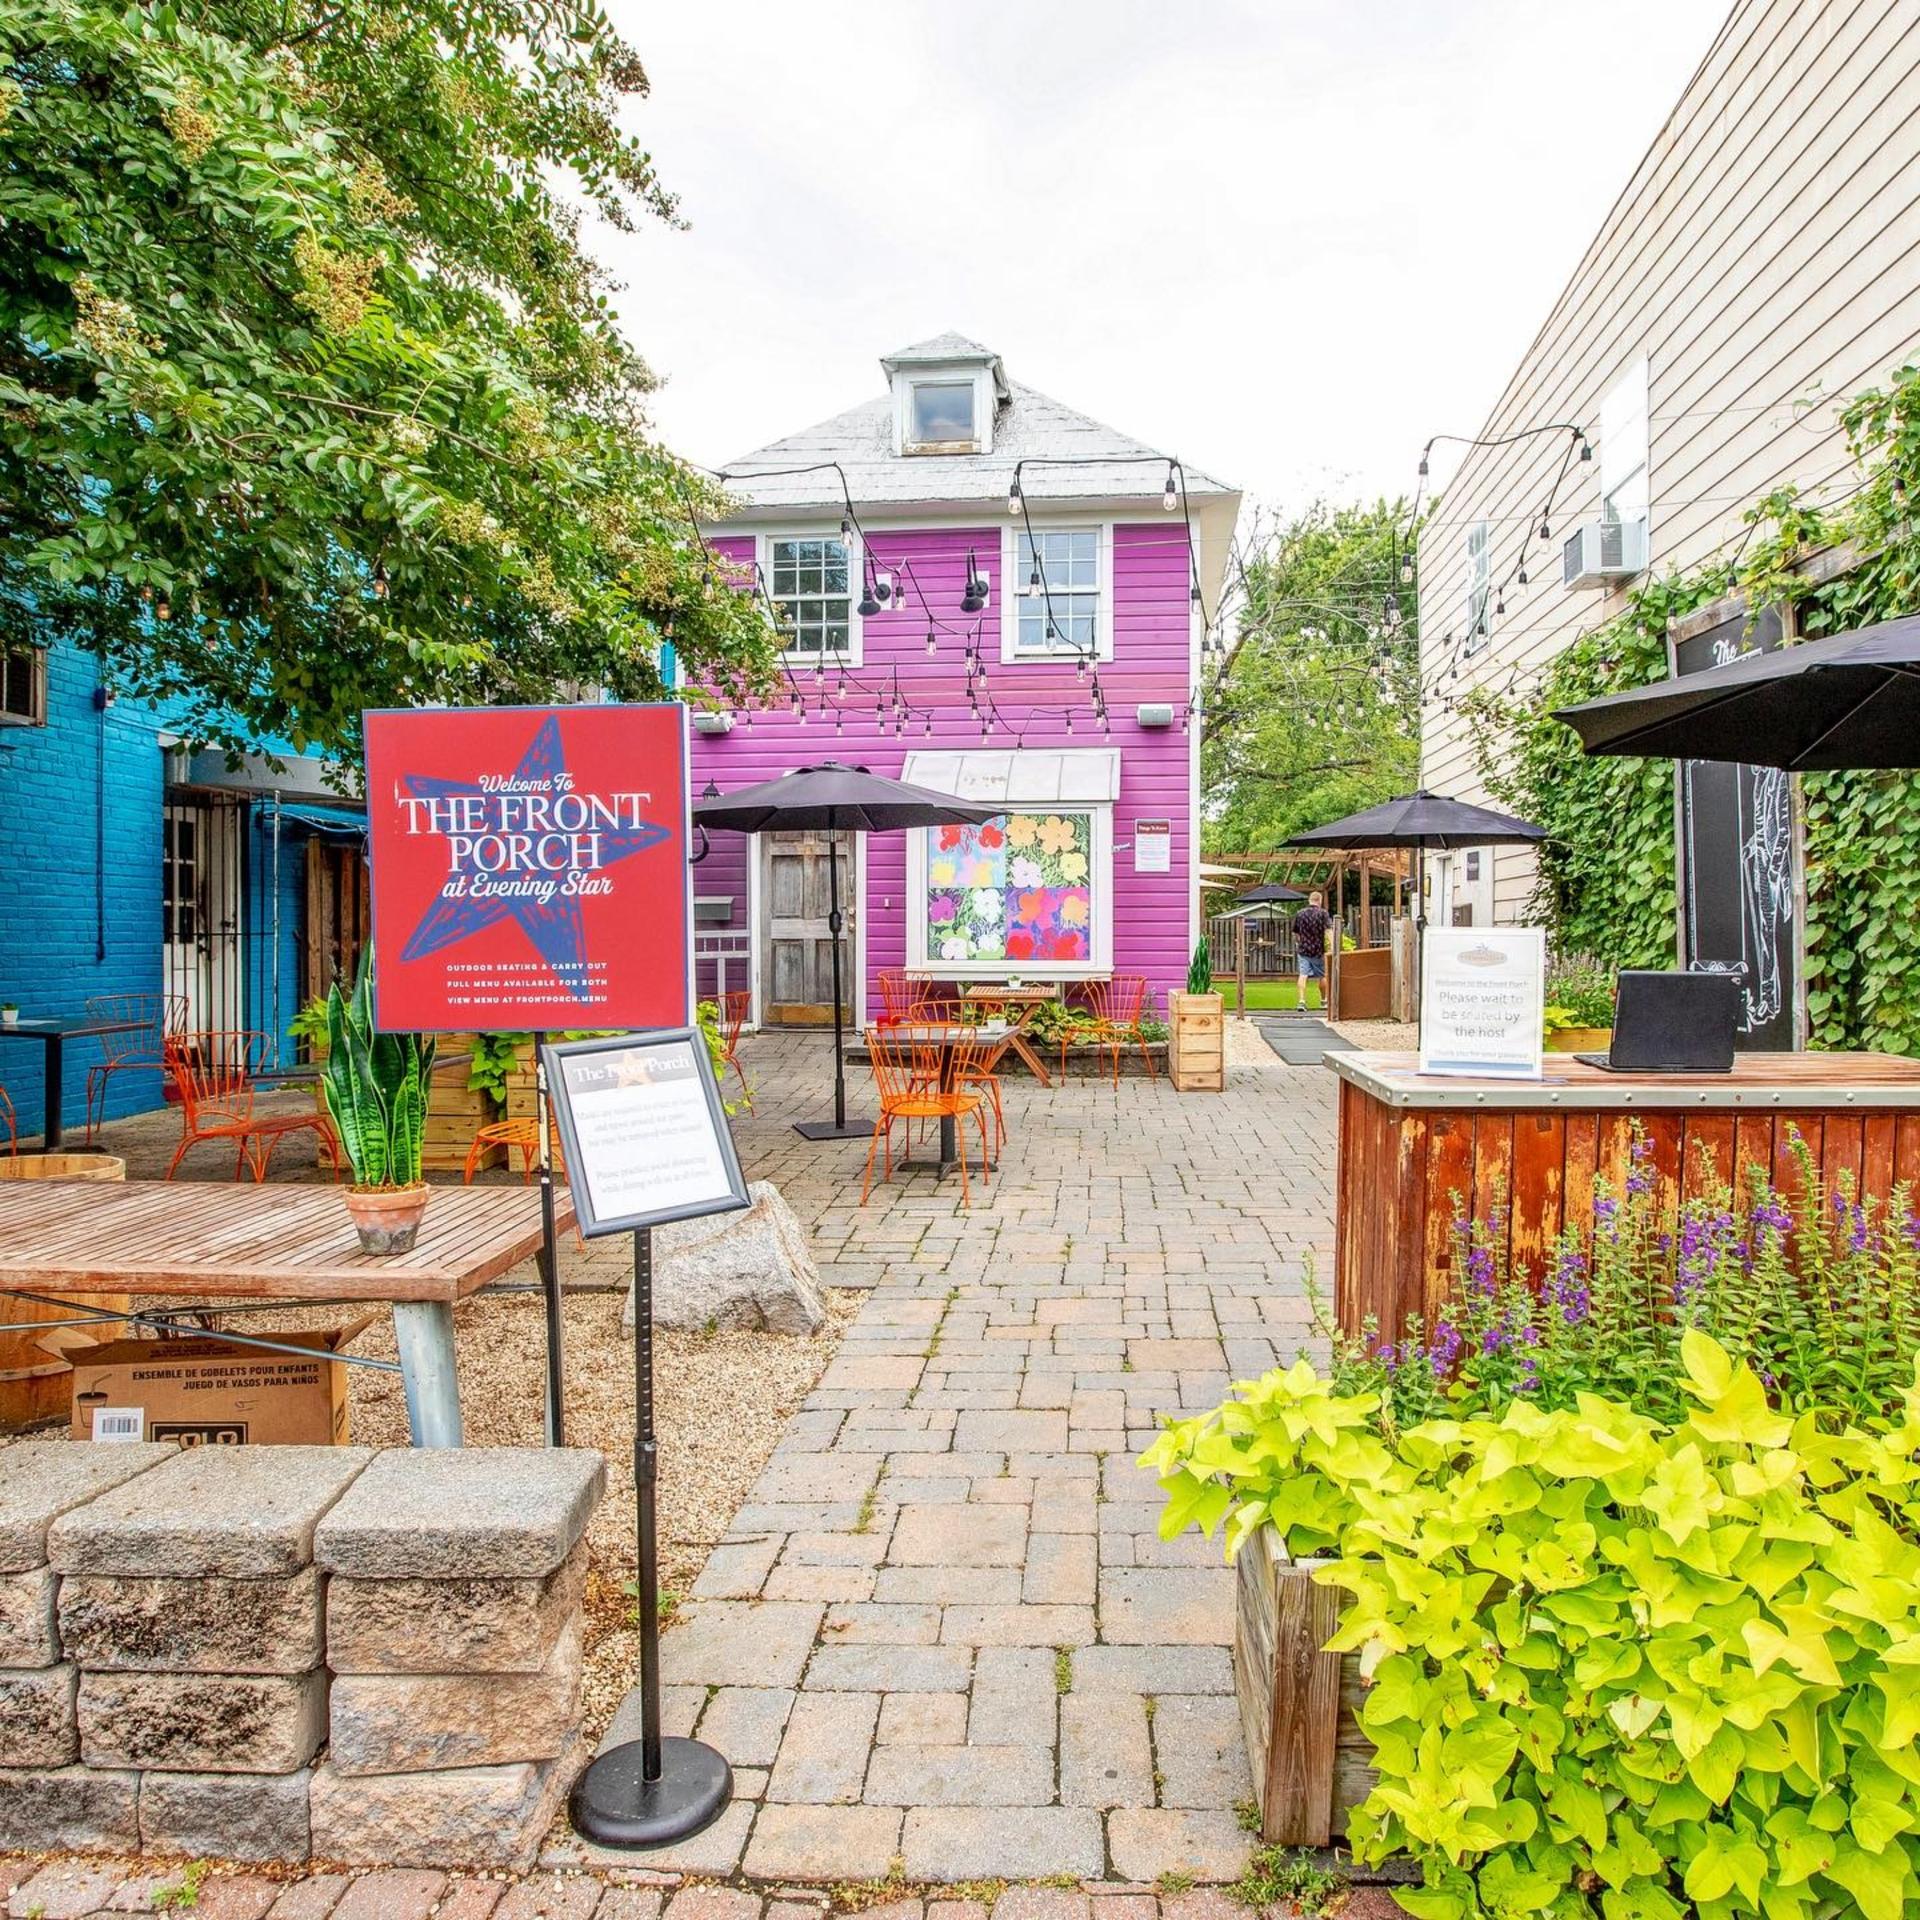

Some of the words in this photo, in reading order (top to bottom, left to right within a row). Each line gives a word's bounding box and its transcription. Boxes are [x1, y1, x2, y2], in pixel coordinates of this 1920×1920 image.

[1712, 639, 1738, 665] The
[478, 773, 552, 793] Welcome
[553, 772, 575, 791] To
[398, 797, 489, 835] THE
[496, 793, 651, 832] FRONT
[446, 833, 604, 872] PORCH
[442, 875, 467, 898] at
[469, 873, 557, 905] Evening
[560, 870, 614, 896] Star
[446, 964, 493, 972] OUTDOOR
[496, 963, 538, 971] SEATING
[541, 963, 548, 971] &
[551, 962, 584, 970] CARRY
[587, 962, 608, 970] OUT
[447, 980, 470, 988] FULL
[473, 980, 500, 988] MENU
[503, 979, 556, 987] AVAILABLE
[559, 979, 578, 987] FOR
[582, 978, 608, 986] BOTH
[447, 997, 471, 1005] VIEW
[473, 996, 500, 1004] MENU
[502, 996, 513, 1004] AT
[516, 995, 608, 1004] FRONTPORCH.MENU
[1439, 991, 1478, 1004] Please
[1481, 992, 1508, 1005] wait
[1511, 993, 1524, 1005] to
[1442, 1010, 1458, 1020] be
[1505, 1010, 1520, 1024] by
[1455, 1027, 1475, 1037] the
[1478, 1026, 1505, 1038] host
[574, 1066, 605, 1083] The
[647, 1055, 690, 1073] Porch
[132, 1368, 183, 1380] ENSEMBLE
[185, 1368, 197, 1378] DE
[200, 1366, 247, 1378] GOBELETS
[250, 1365, 275, 1376] POUR
[278, 1363, 319, 1375] ENFANTS
[183, 1380, 214, 1390] JUEGO
[216, 1379, 228, 1389] DE
[232, 1378, 261, 1388] VASOS
[264, 1376, 288, 1387] PARA
[291, 1374, 320, 1386] NIÑOS
